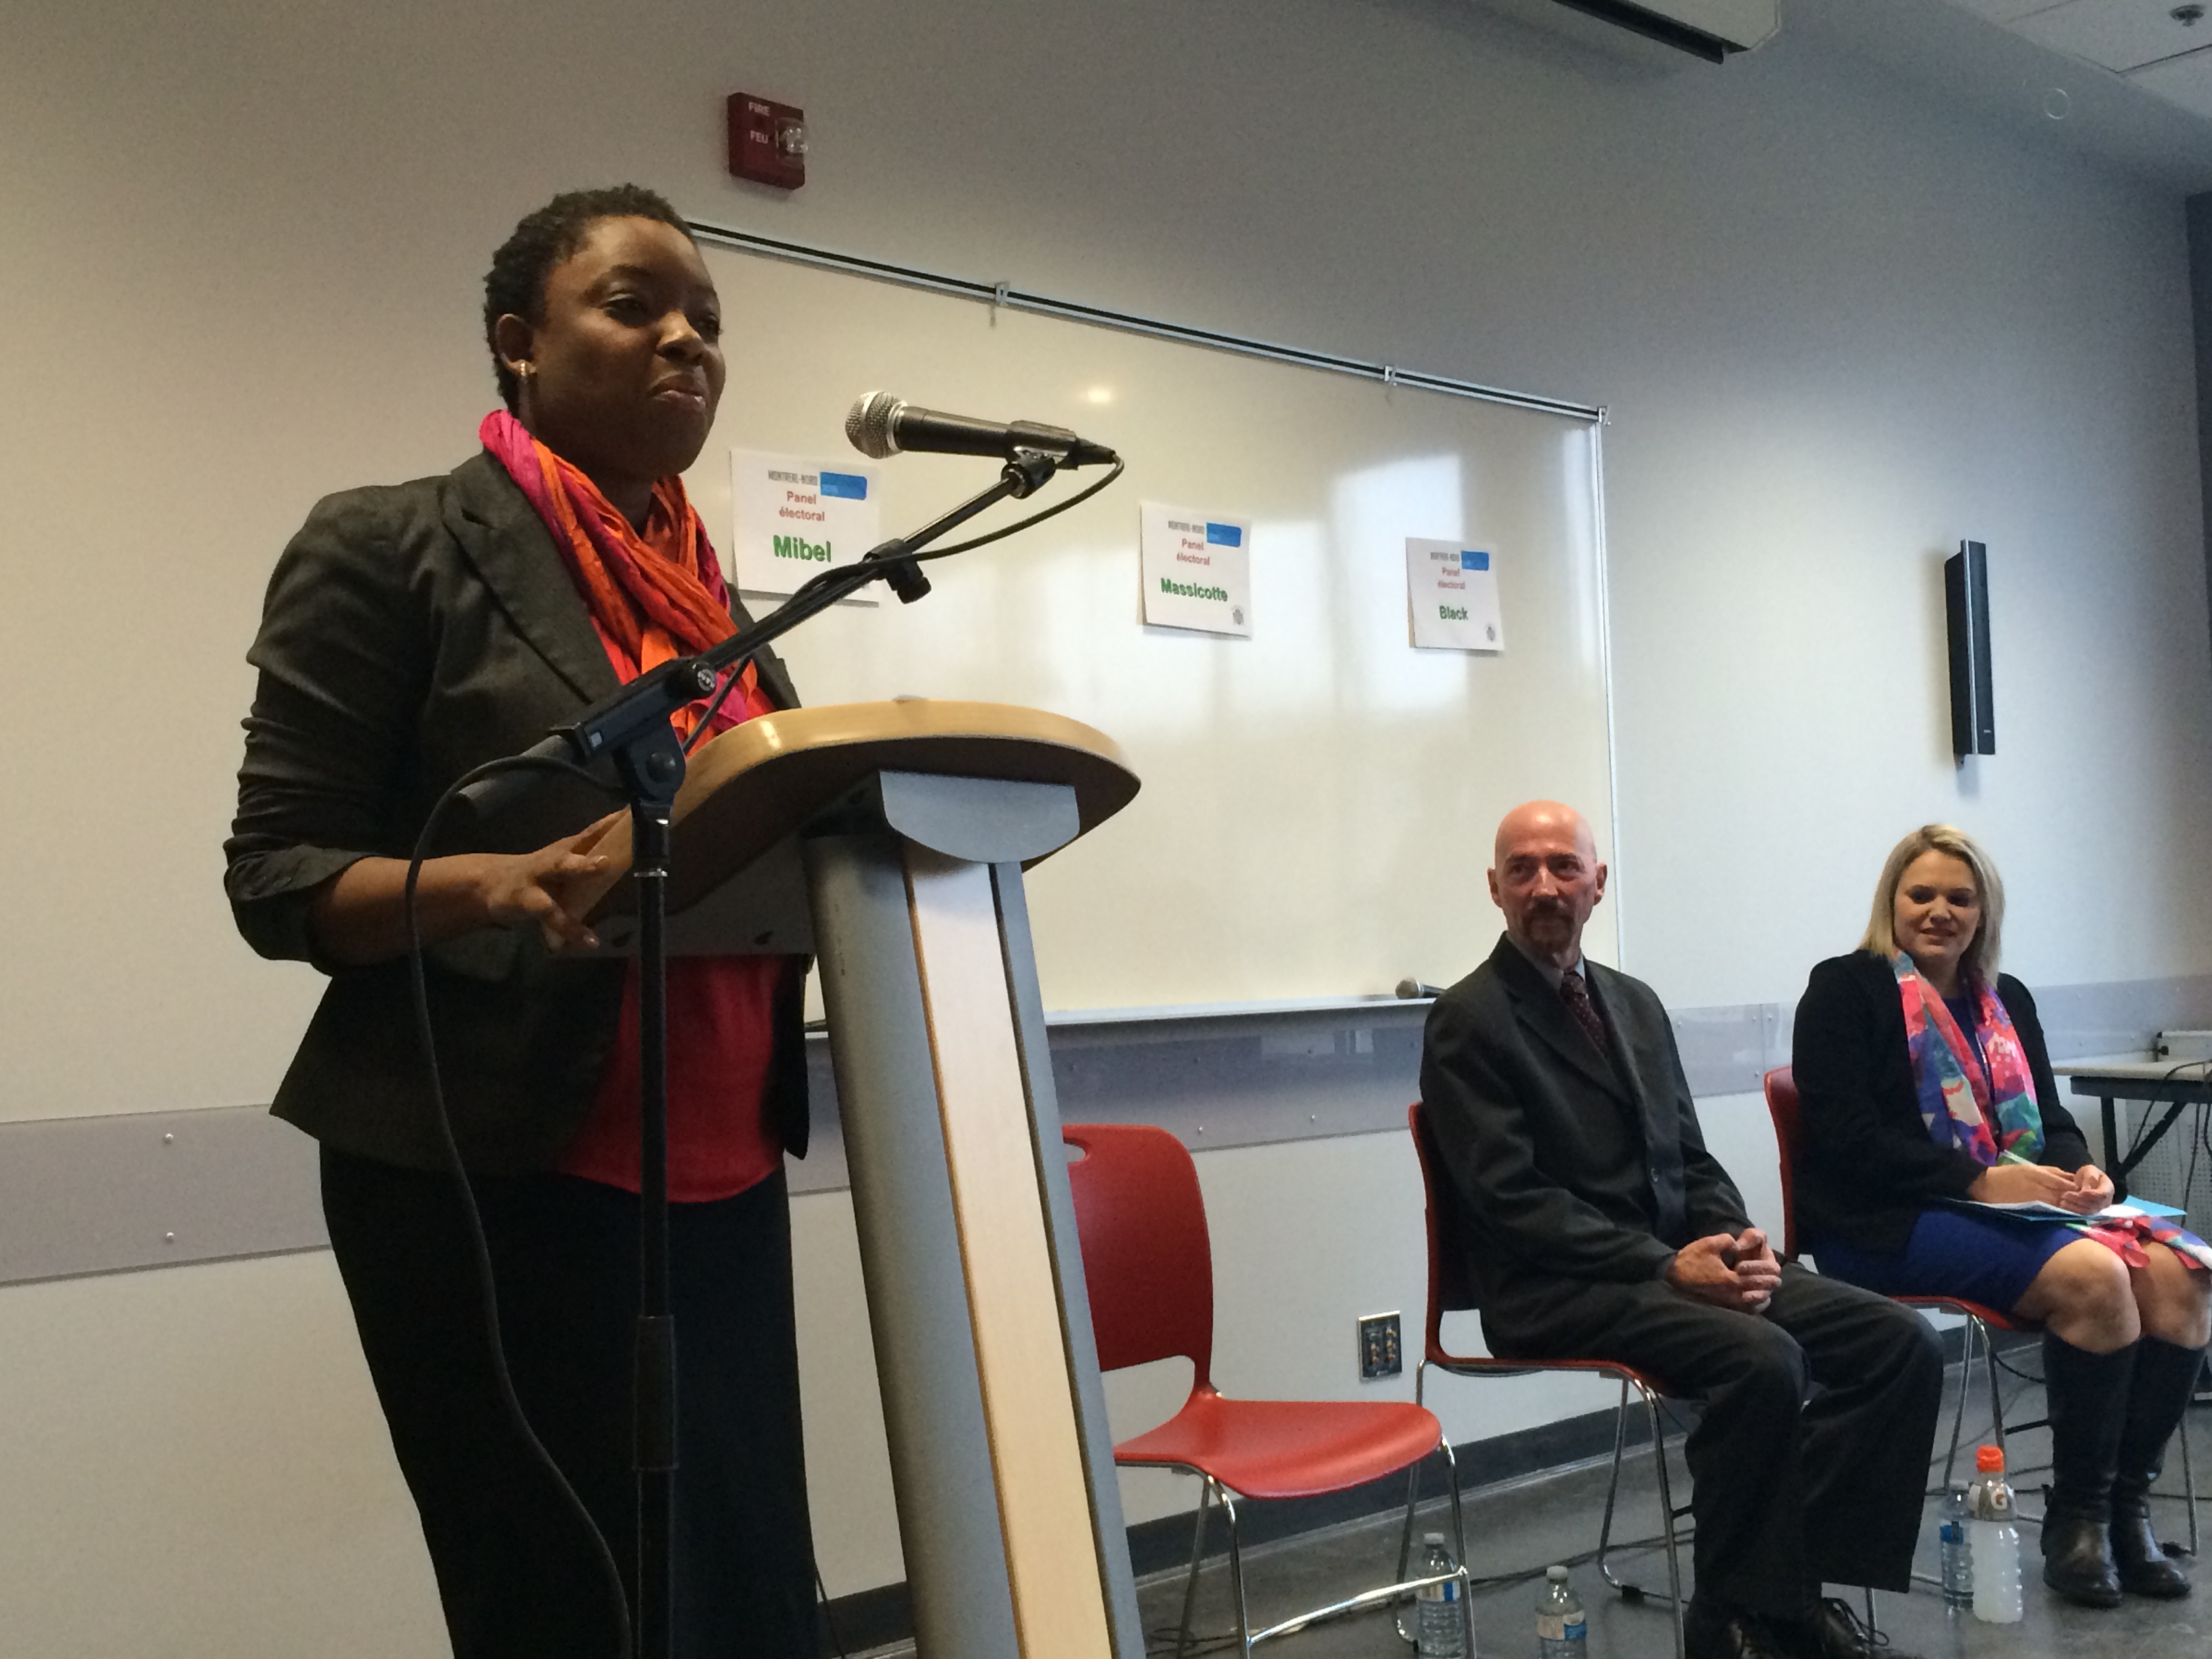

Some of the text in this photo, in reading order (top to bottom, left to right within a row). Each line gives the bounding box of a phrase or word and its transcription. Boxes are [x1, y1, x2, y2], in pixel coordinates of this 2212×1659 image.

[748, 102, 770, 117] FIRE
[750, 130, 769, 144] FEU
[787, 491, 817, 504] Panel
[779, 506, 825, 521] électoral
[773, 535, 832, 562] Mibel
[1182, 538, 1204, 550] Panel
[1160, 577, 1228, 602] Massicotte
[1439, 605, 1469, 620] Black
